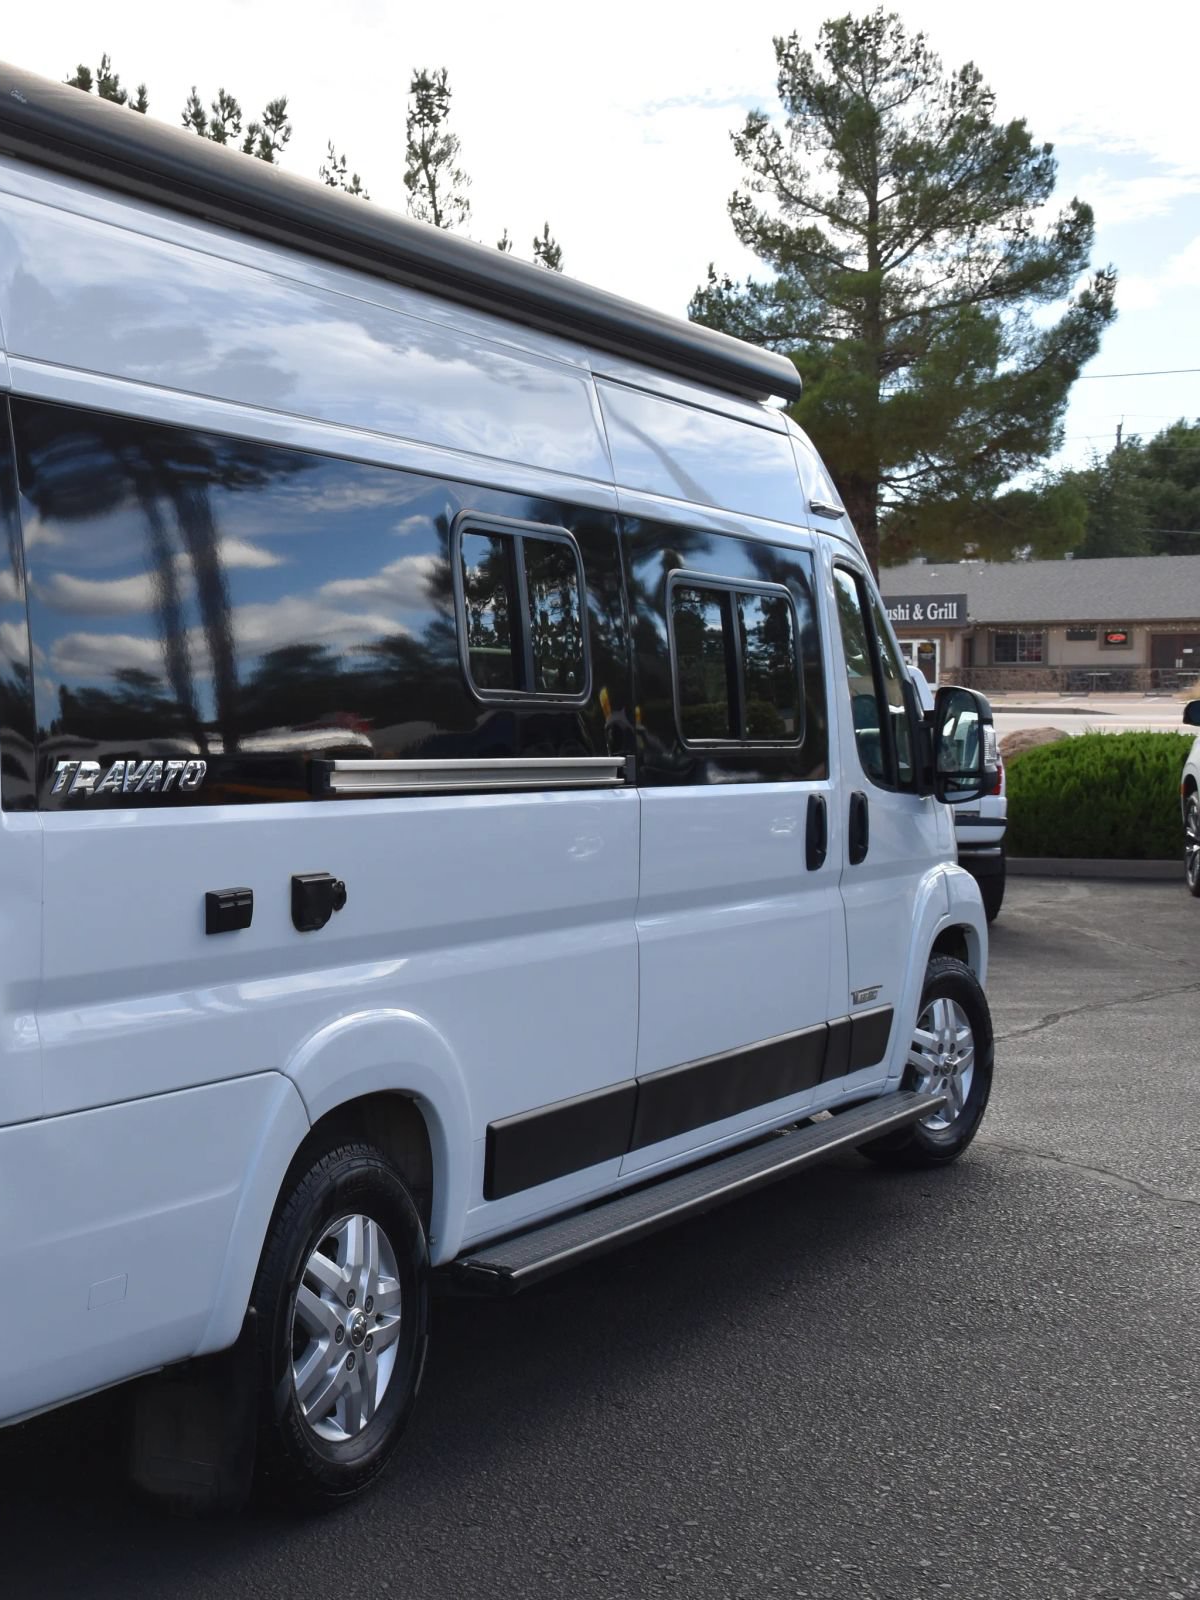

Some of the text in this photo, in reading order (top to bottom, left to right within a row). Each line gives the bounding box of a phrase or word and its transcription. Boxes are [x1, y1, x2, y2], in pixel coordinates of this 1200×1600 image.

[886, 602, 957, 621] ushi & Grill
[51, 760, 207, 795] TRAVATO
